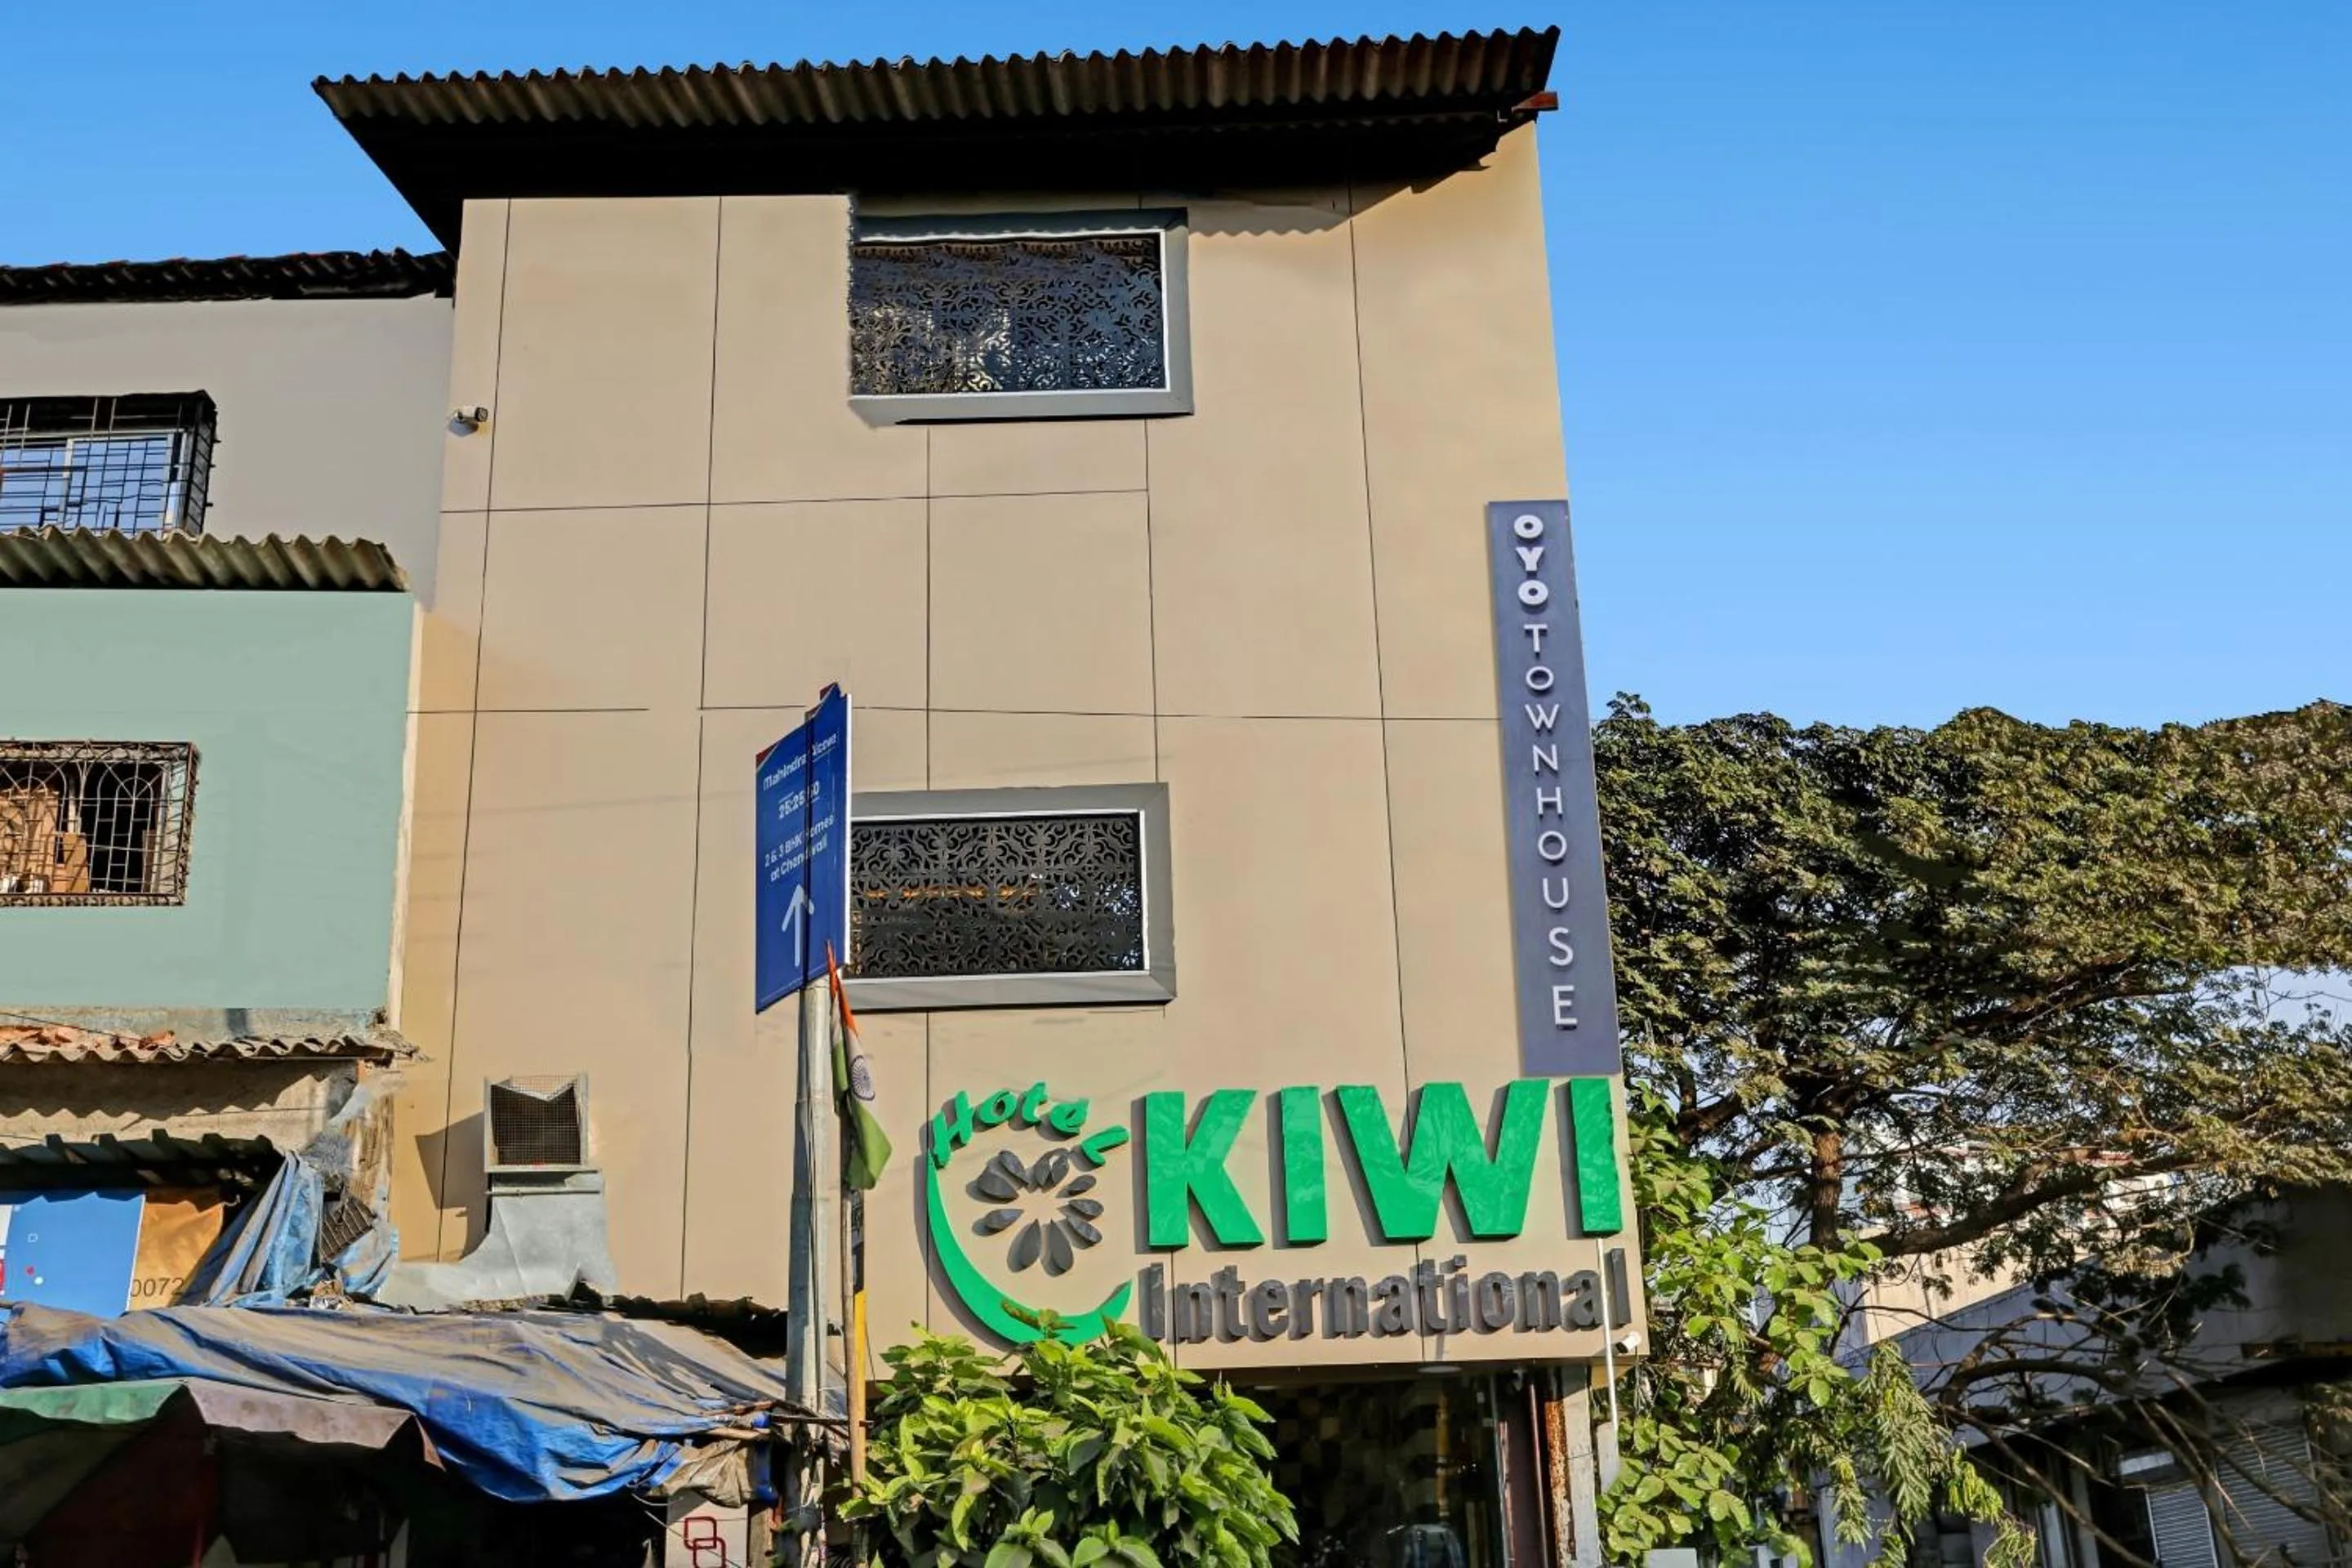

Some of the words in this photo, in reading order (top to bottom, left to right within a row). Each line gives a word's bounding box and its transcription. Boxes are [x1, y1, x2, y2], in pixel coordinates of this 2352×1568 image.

[1513, 514, 1550, 607] OYO
[763, 753, 807, 791] Mahindra
[764, 853, 770, 867] 2
[779, 843, 784, 858] 3
[770, 866, 780, 882] at
[781, 832, 827, 875] Chanvali
[1523, 623, 1579, 1029] TOWNHOUSE
[933, 1080, 1130, 1170] Hotel
[1145, 1077, 1624, 1248] KIWI
[1147, 1247, 1632, 1344] International
